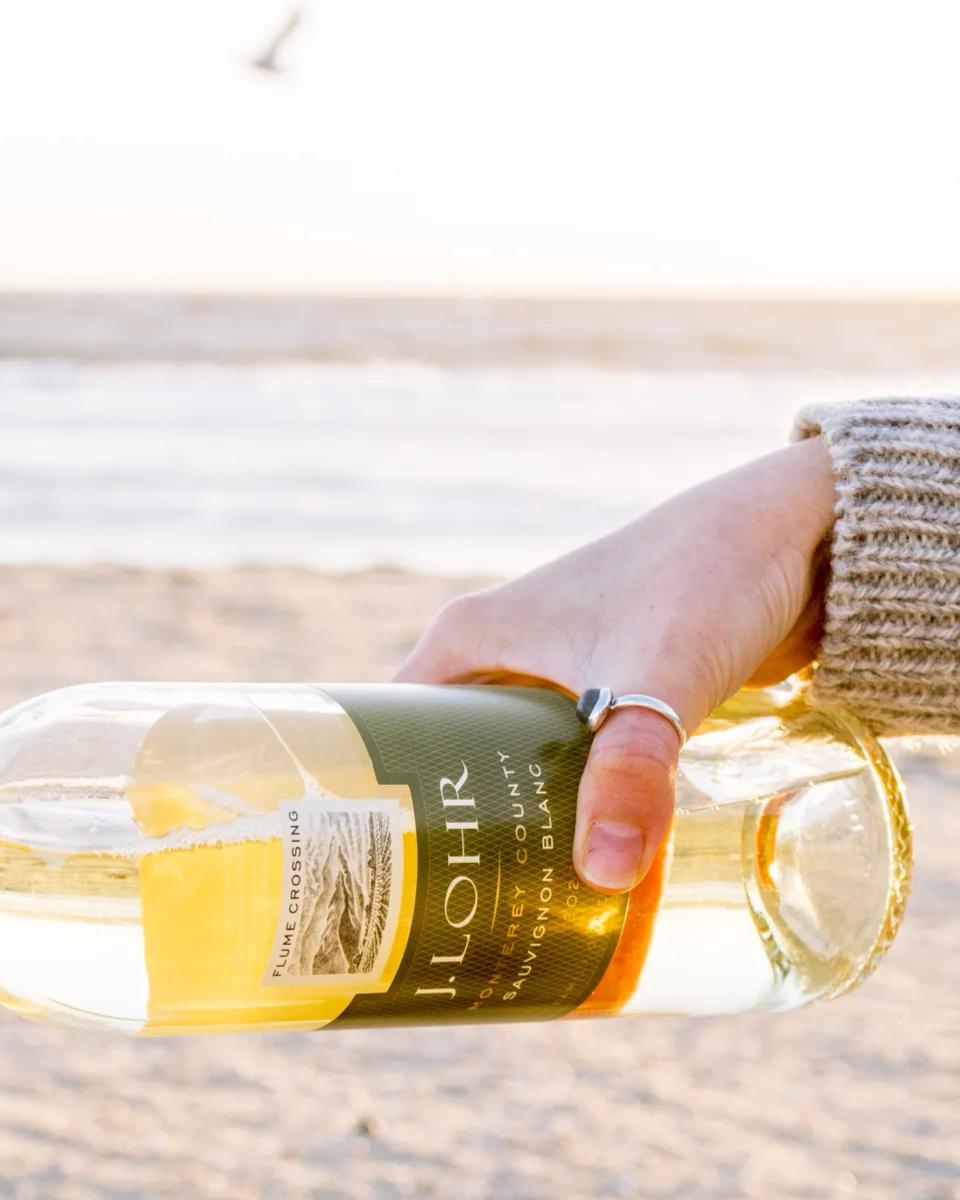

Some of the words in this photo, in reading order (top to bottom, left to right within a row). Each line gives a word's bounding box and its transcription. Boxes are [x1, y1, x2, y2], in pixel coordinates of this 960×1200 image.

[271, 921, 296, 977] FLUME
[288, 810, 302, 914] CROSSING
[467, 885, 525, 1010] MONTEREY
[497, 751, 527, 864] COUNTY
[502, 868, 554, 1000] SAUVIGNON
[528, 763, 554, 850] BLANC
